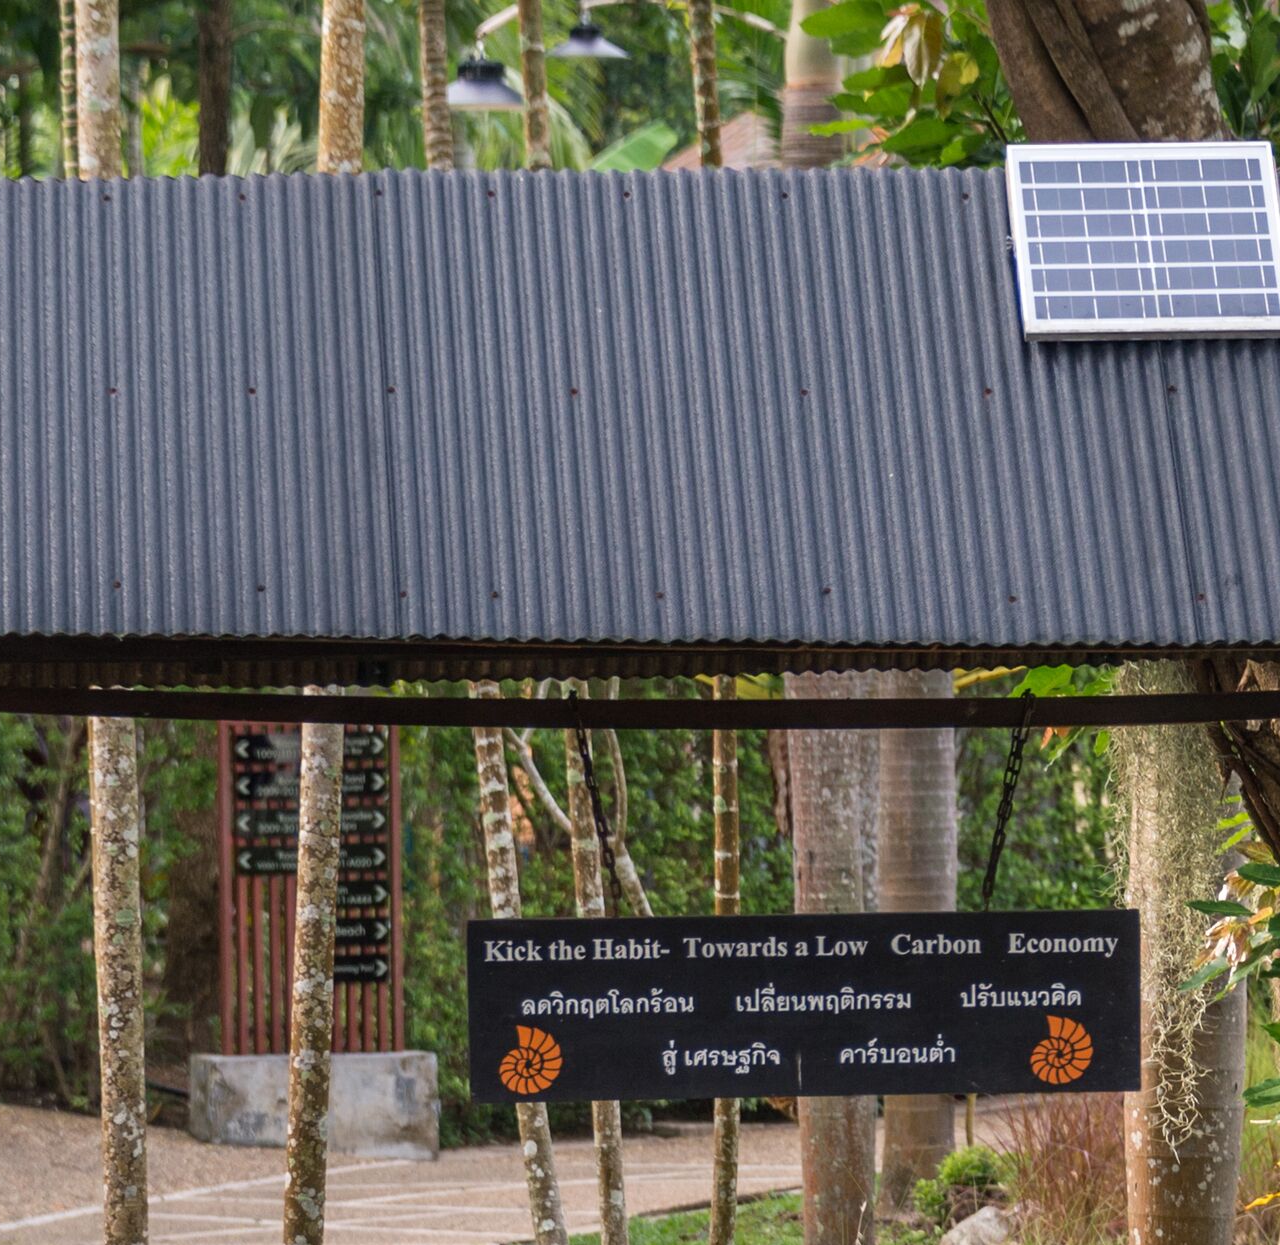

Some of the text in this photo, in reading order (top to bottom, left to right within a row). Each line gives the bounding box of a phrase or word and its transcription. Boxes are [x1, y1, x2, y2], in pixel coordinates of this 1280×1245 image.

[484, 933, 1119, 962] Kick the Habit- Towards a Low Carbon Economy
[521, 982, 1082, 1019] ลดวิกฤตโลกร้อน เปลี่ยนพฤติกรรม ปรับแนวคิด
[661, 1033, 956, 1076] สู่ เศรษฐกิจ คาร์บอนต่ำ
